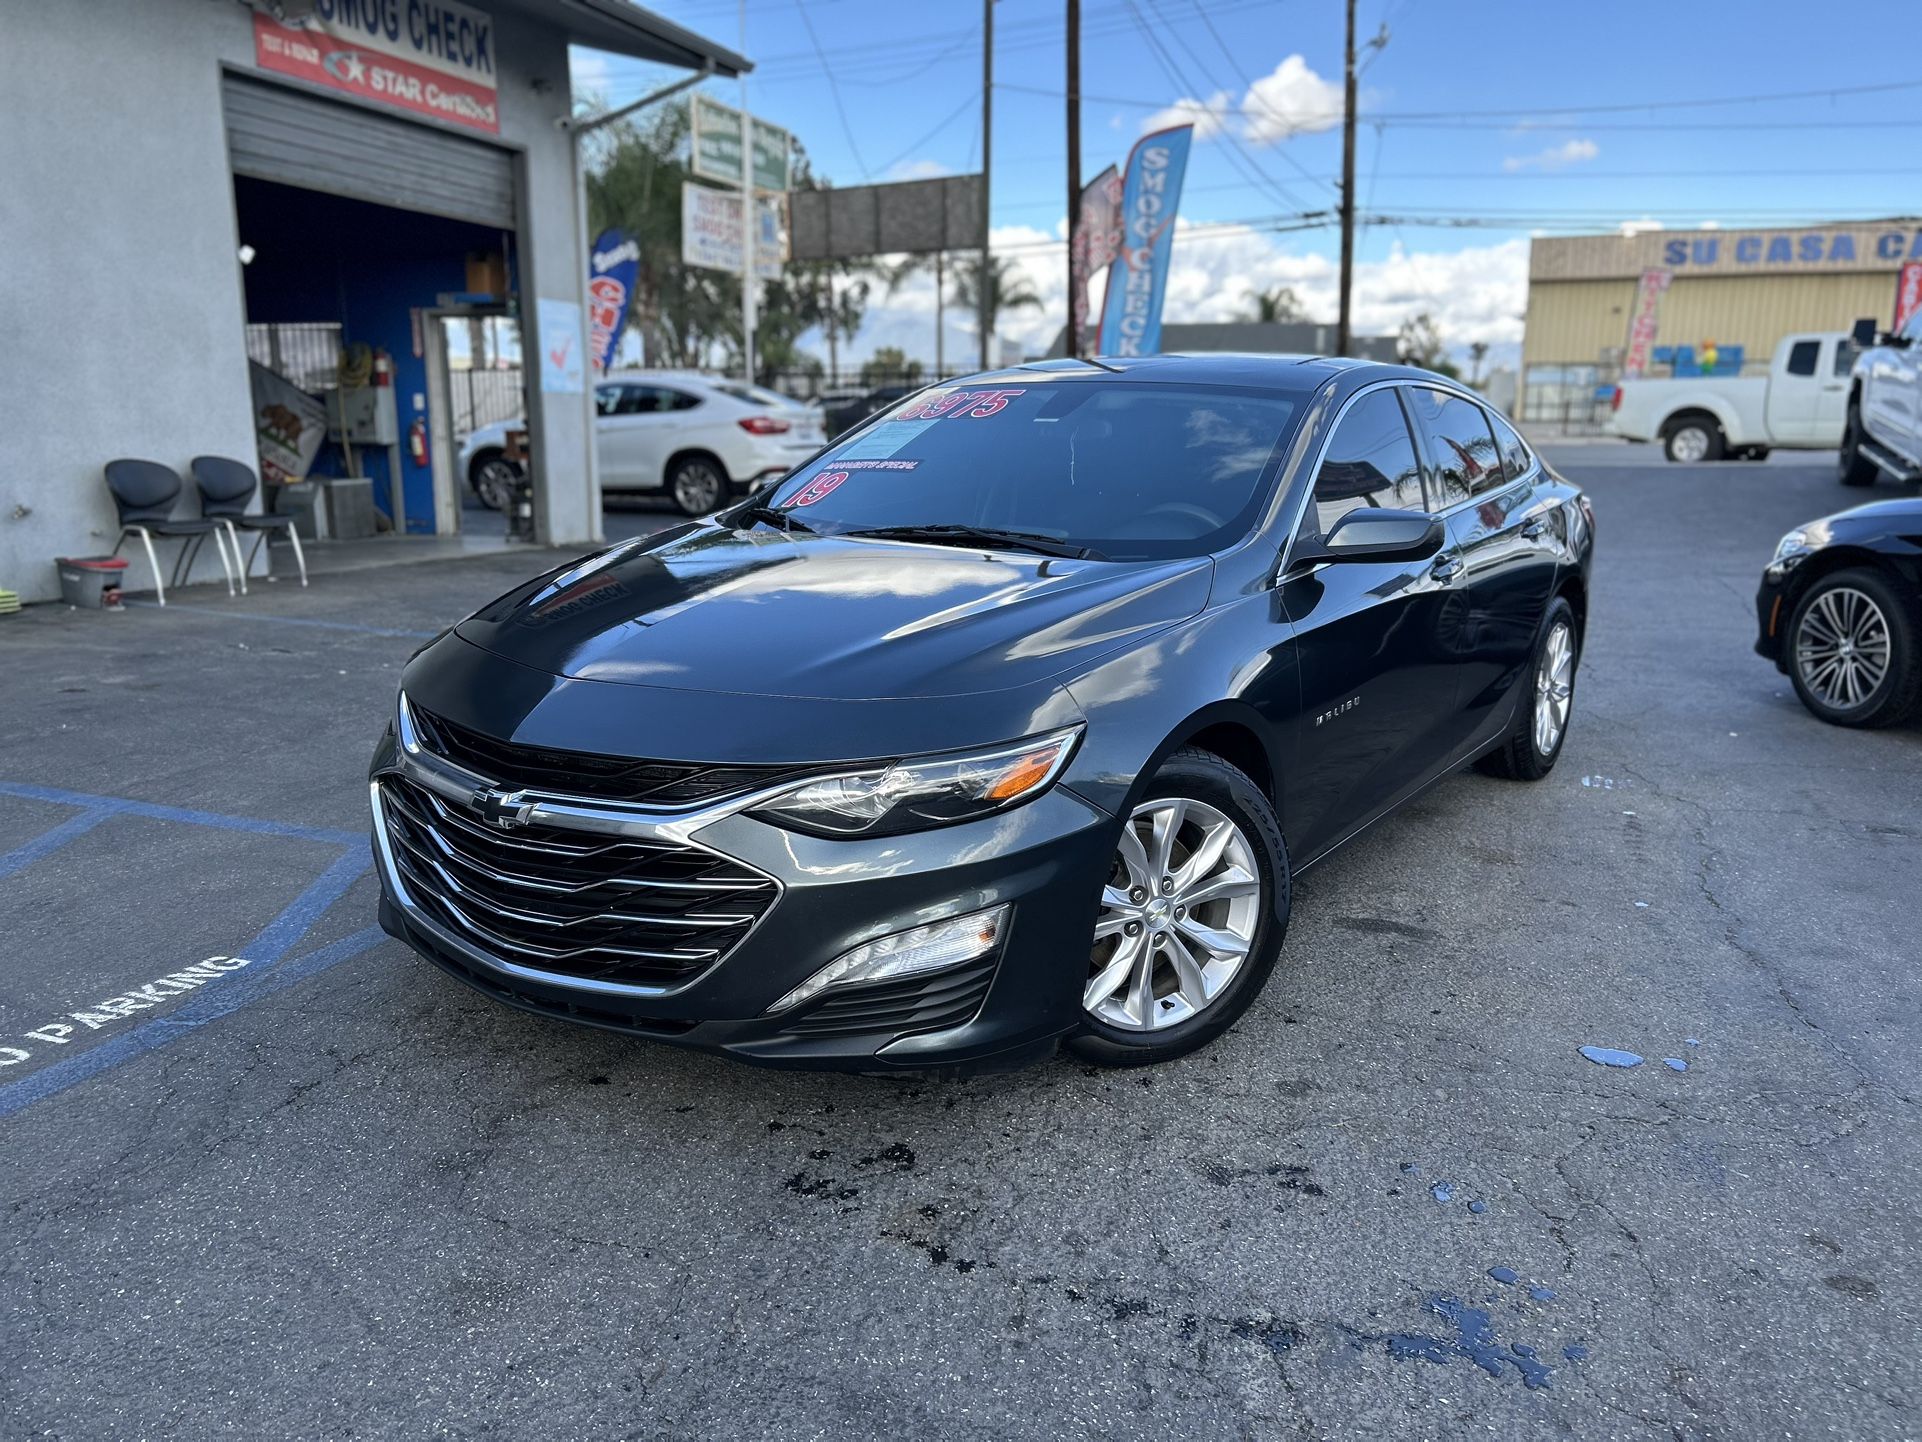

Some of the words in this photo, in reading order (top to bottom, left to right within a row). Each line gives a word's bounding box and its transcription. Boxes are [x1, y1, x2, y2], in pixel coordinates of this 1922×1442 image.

[407, 0, 492, 75] CHECK
[370, 66, 422, 103] STAR
[1664, 239, 1719, 266] SU
[1735, 232, 1857, 264] CASA
[1119, 246, 1155, 357] CHECK
[781, 471, 849, 508] 19
[1315, 696, 1360, 727] MALIBU
[23, 955, 253, 1045] PARKING
